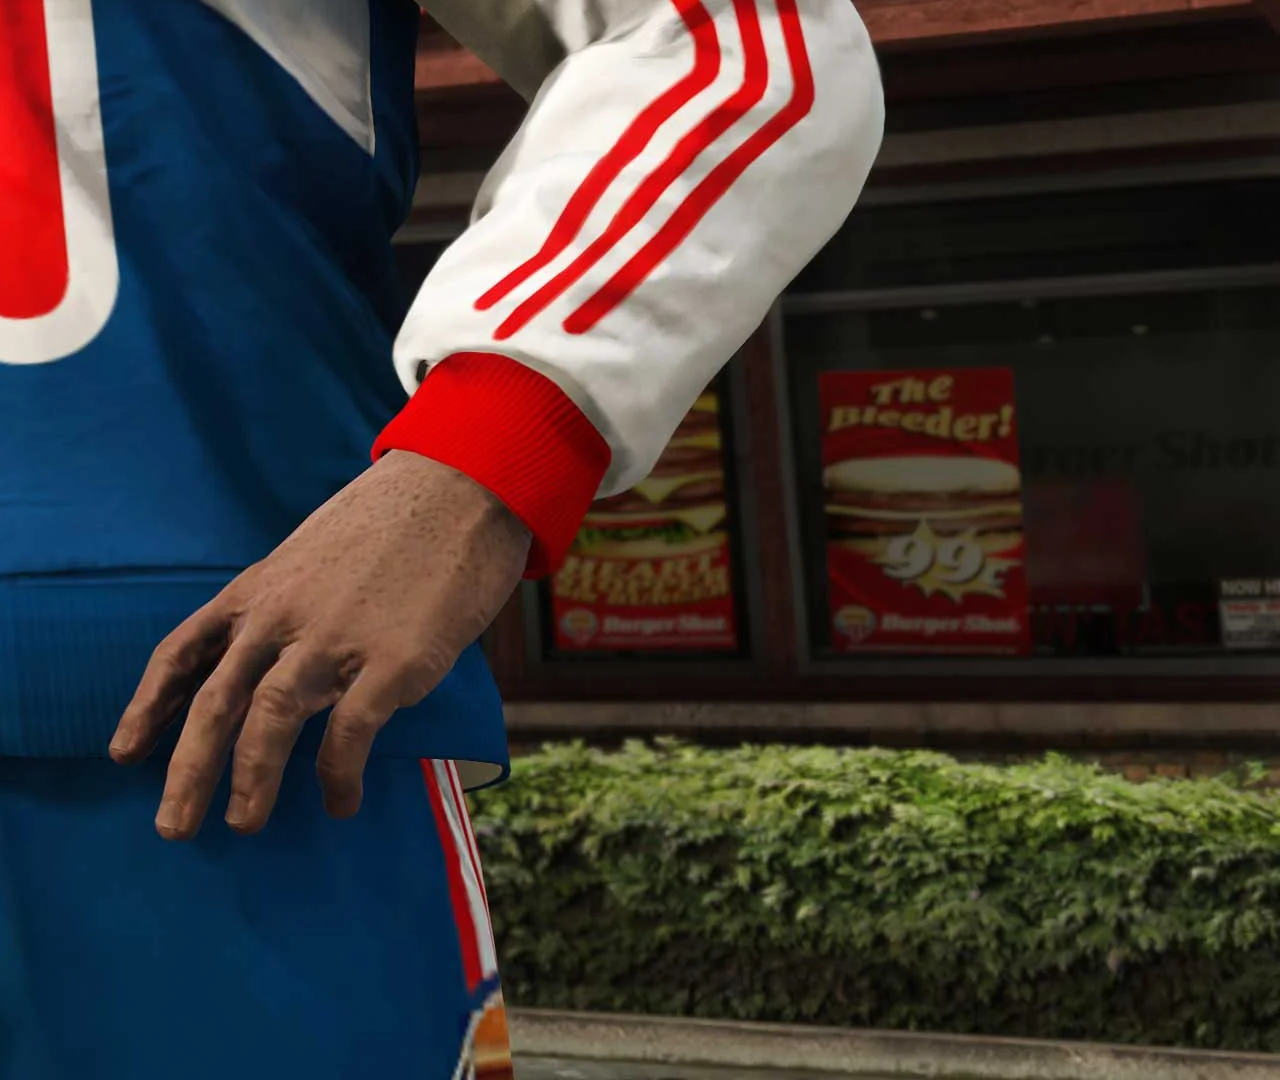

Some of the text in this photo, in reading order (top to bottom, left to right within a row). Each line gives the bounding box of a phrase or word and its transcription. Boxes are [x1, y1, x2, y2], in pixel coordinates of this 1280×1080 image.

[869, 375, 954, 405] The
[827, 403, 1014, 442] Bleeder!
[560, 552, 722, 579] HEART
[602, 614, 727, 635] Burger Shot
[880, 613, 960, 636] Burger
[962, 614, 1021, 633] Shot
